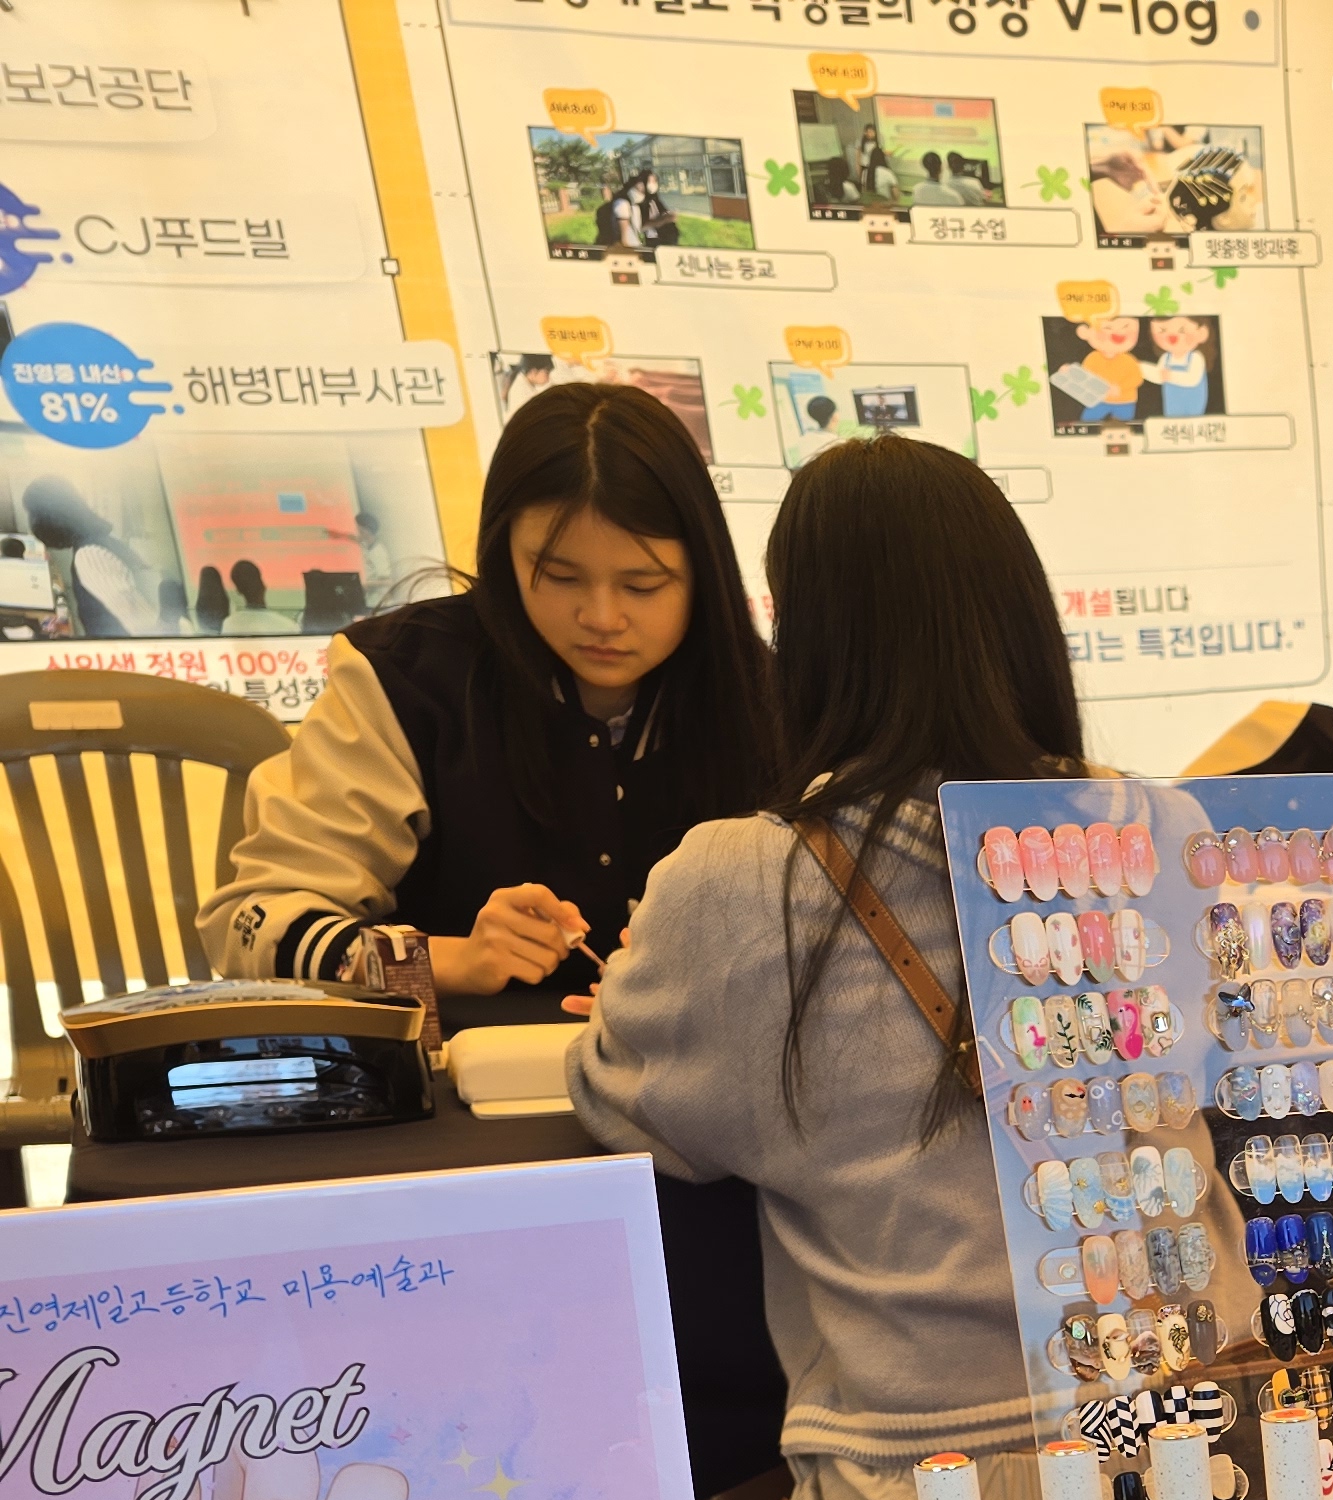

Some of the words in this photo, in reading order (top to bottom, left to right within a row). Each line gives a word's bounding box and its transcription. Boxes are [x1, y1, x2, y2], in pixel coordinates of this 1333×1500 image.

[1, 62, 193, 112] 보건공단
[74, 214, 290, 260] CJ푸드빌
[929, 217, 966, 240] 정규
[970, 218, 1007, 241] 수업
[675, 254, 734, 279] 신나는
[739, 258, 777, 281] 등교
[183, 365, 447, 407] 해병대부사관
[40, 391, 119, 423] 81%
[1062, 585, 1191, 618] 개설됩니다
[219, 650, 308, 677] 100%
[0, 1276, 266, 1334] 진영제일고등학교
[283, 1254, 455, 1308] 미용예술과
